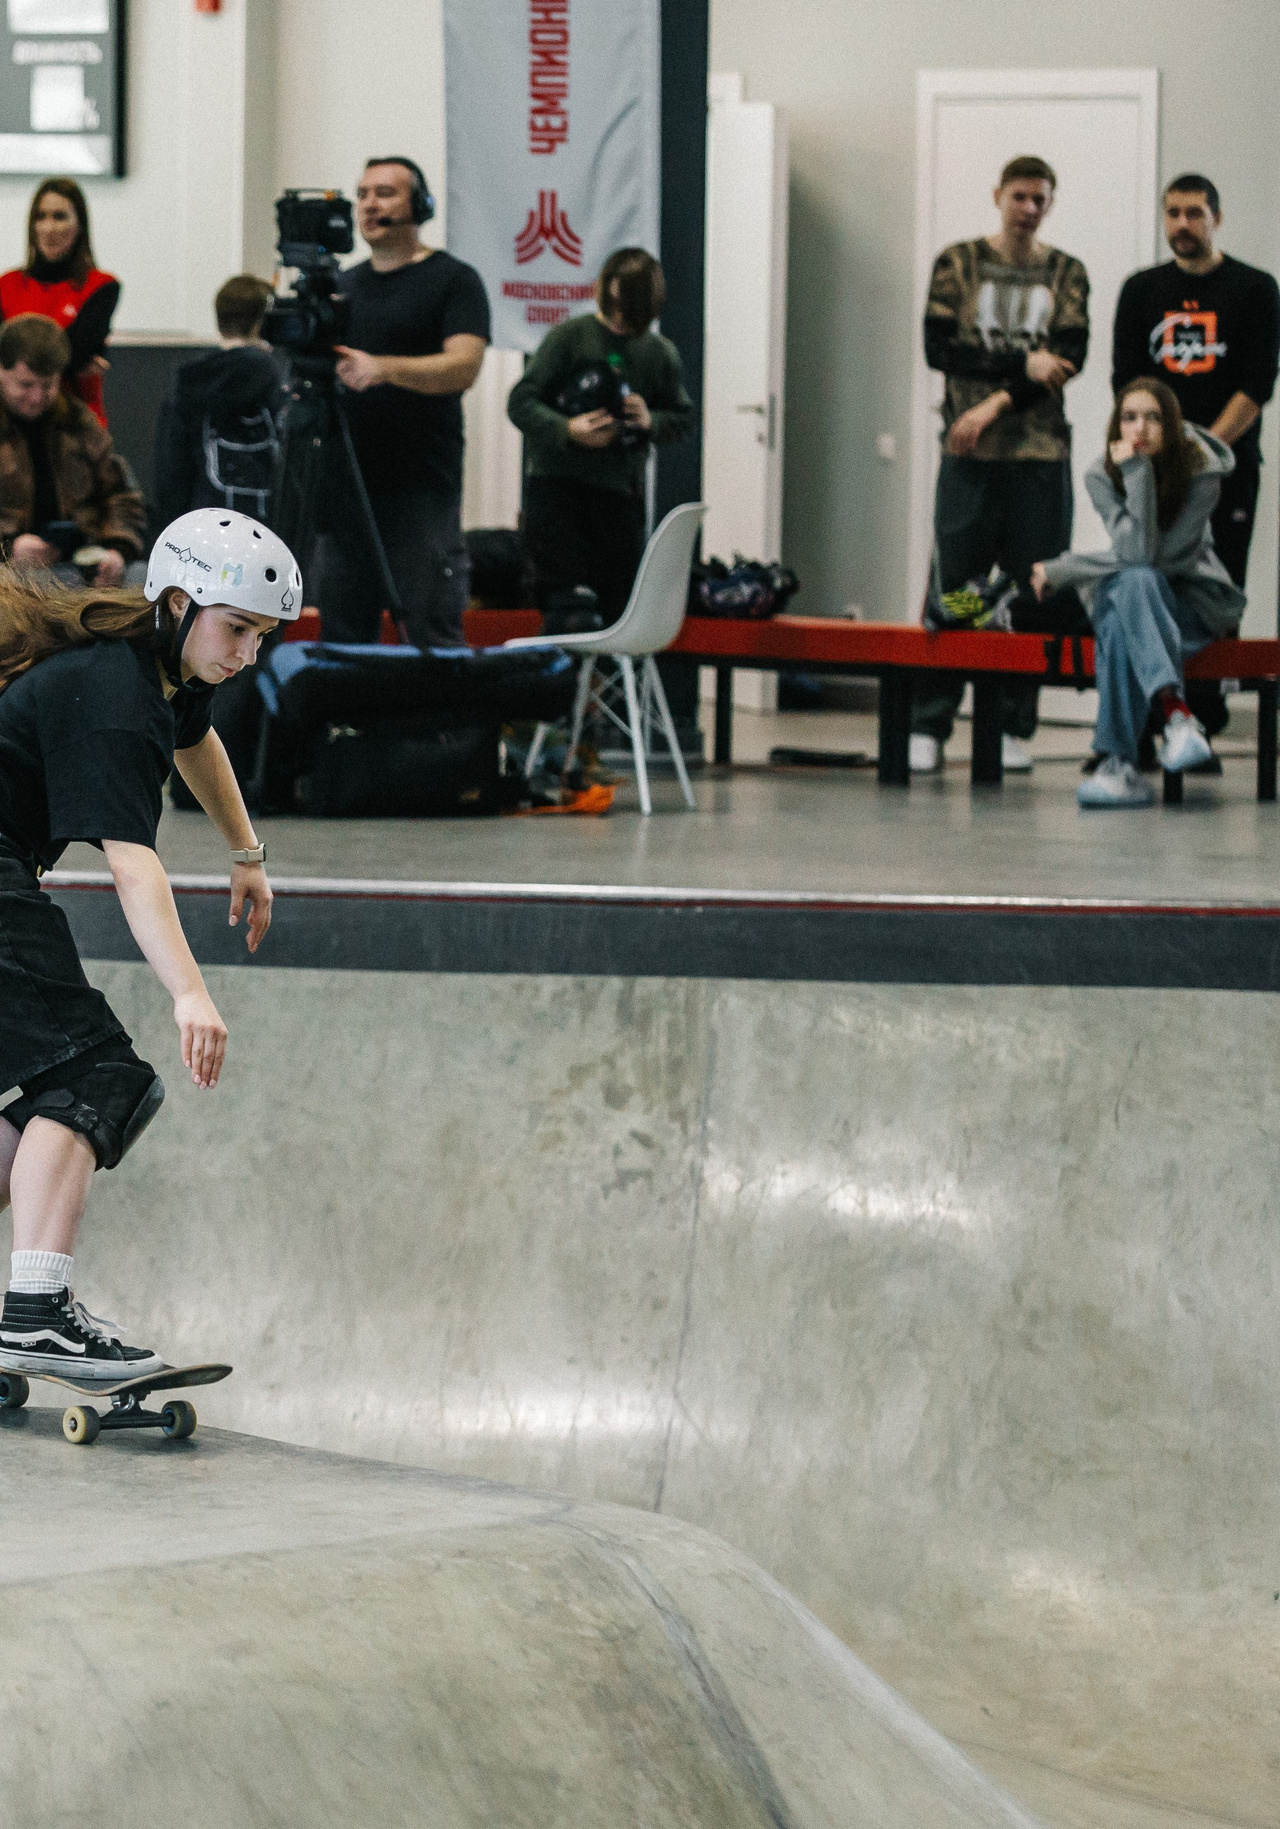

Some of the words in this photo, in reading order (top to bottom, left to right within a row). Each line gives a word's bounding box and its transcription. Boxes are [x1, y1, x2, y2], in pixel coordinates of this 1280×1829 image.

[530, 0, 568, 154] ЧЕМПИОН
[165, 541, 181, 554] PRO
[191, 556, 212, 572] TEC
